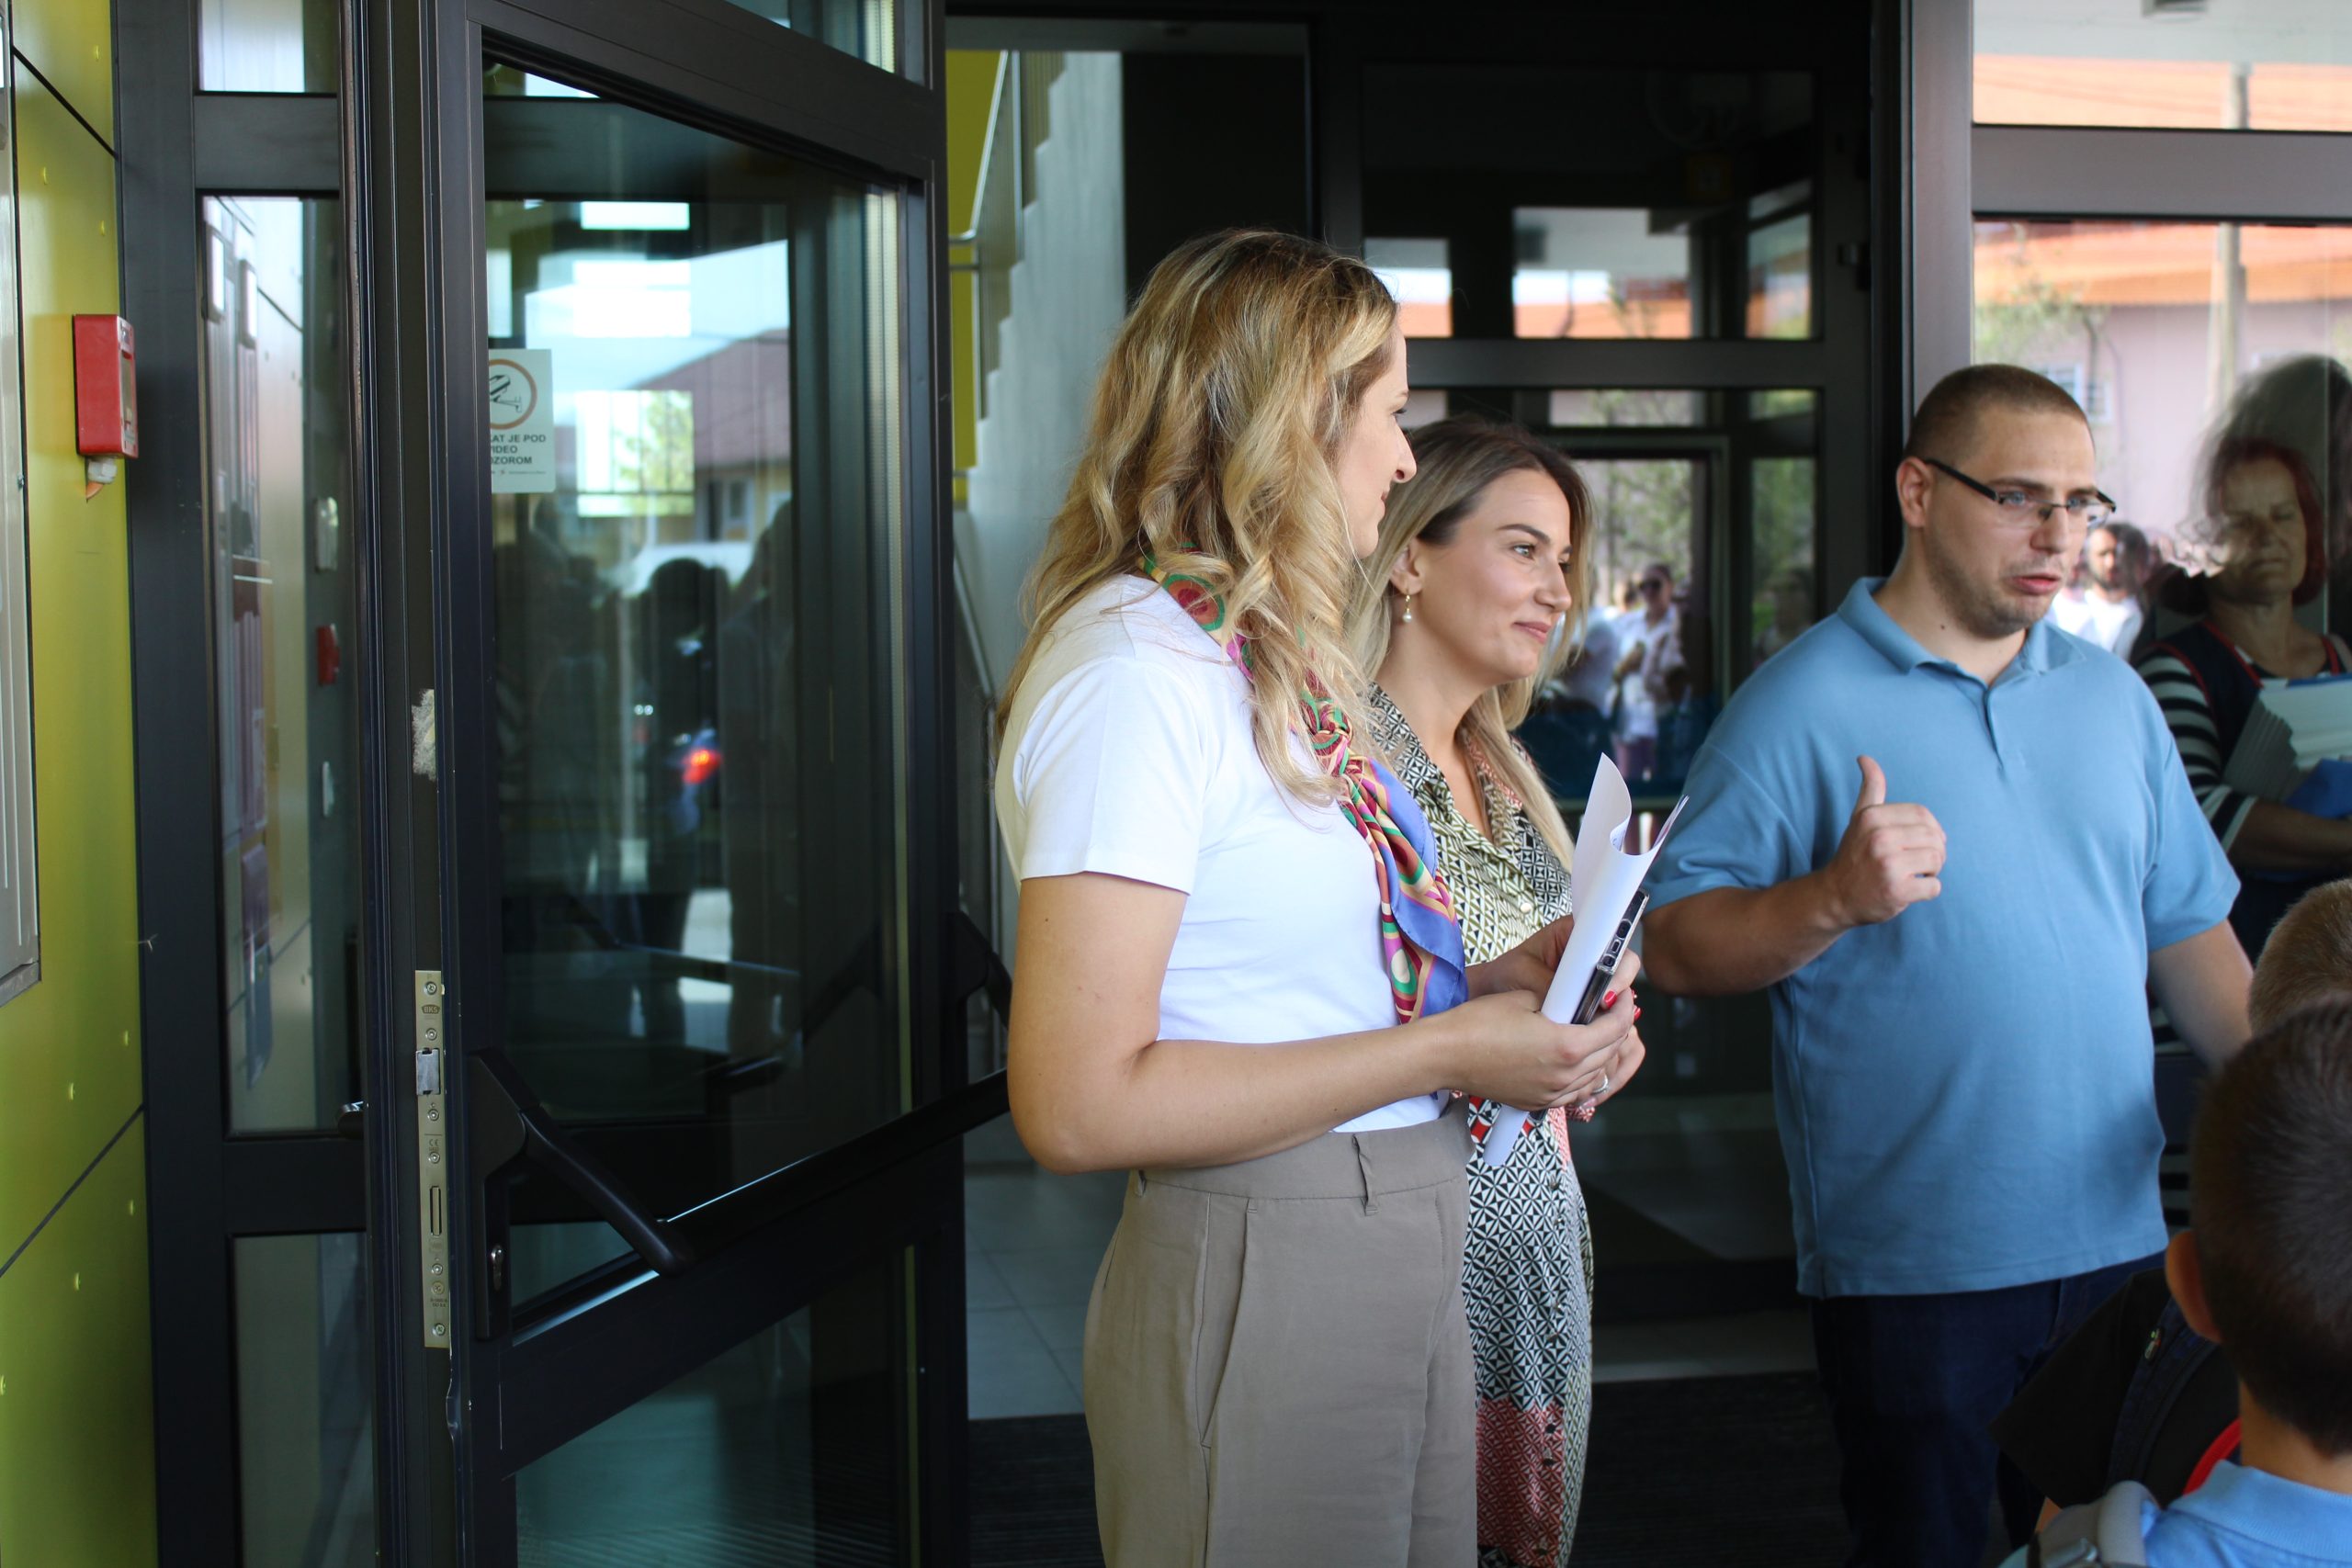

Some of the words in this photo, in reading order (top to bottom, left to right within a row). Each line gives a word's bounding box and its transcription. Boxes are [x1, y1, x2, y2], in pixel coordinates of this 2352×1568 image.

[491, 434, 505, 443] AT
[508, 434, 520, 443] JE
[523, 434, 547, 443] POD
[491, 445, 518, 454] IDEO
